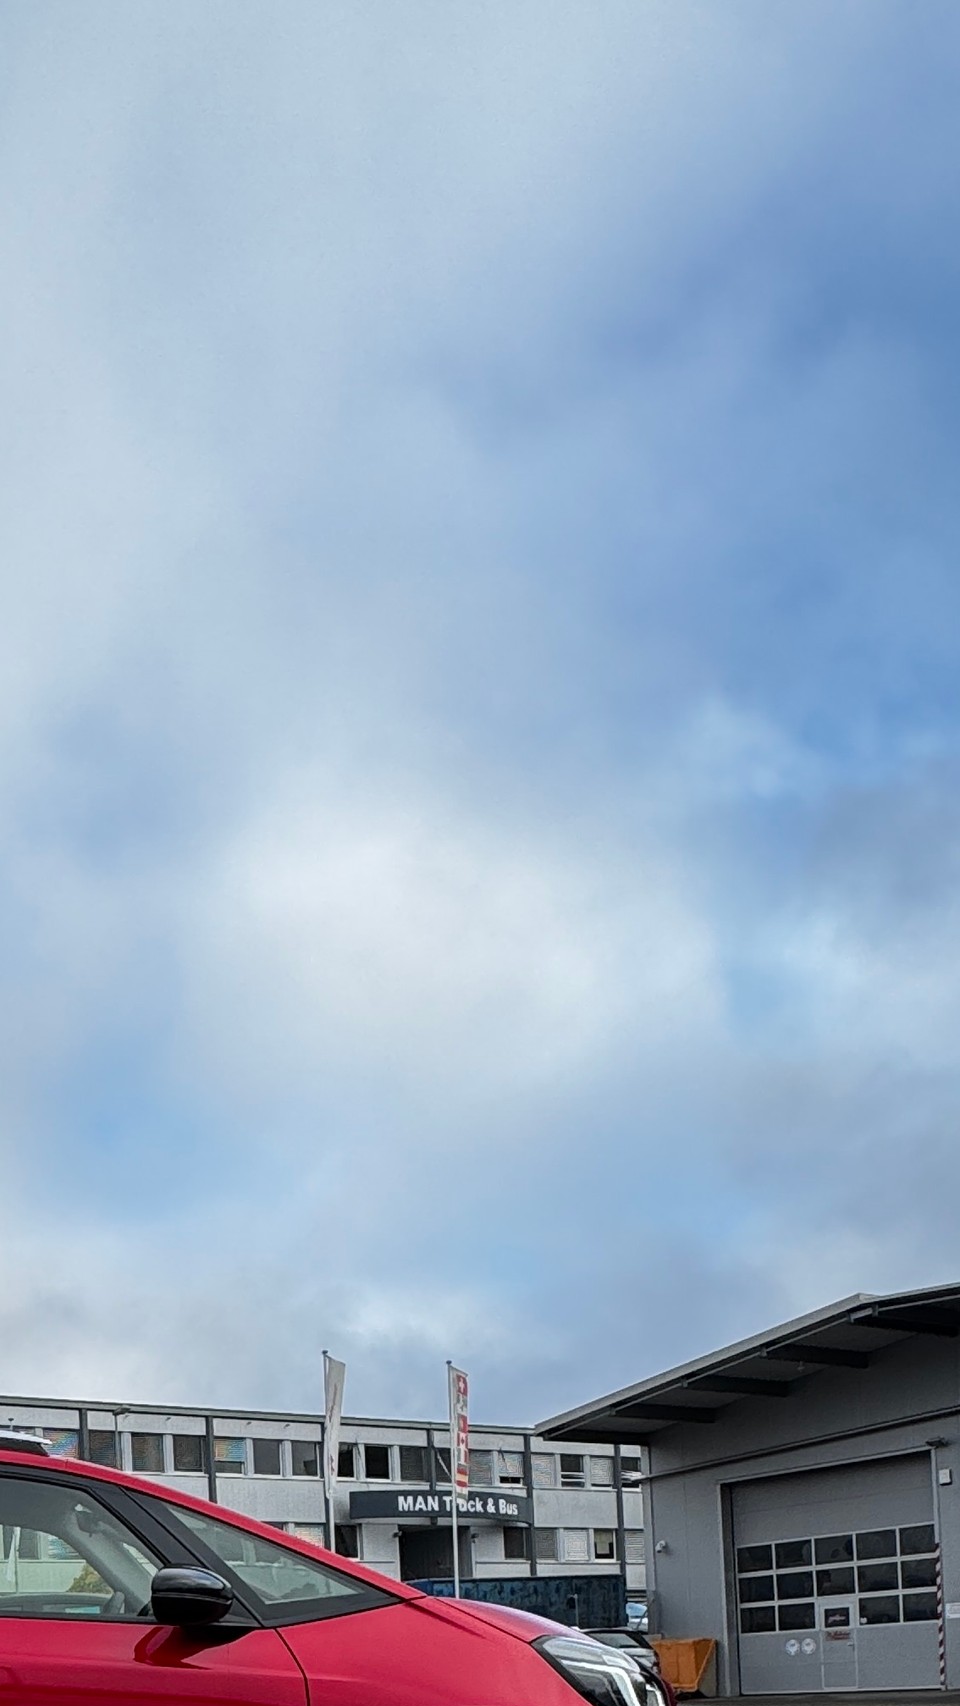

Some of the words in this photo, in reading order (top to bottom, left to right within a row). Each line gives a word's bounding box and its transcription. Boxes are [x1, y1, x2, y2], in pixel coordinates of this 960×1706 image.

[397, 1495, 440, 1512] MAN
[442, 1495, 485, 1513] Tuck
[486, 1497, 496, 1514] &
[498, 1498, 519, 1516] Bus
